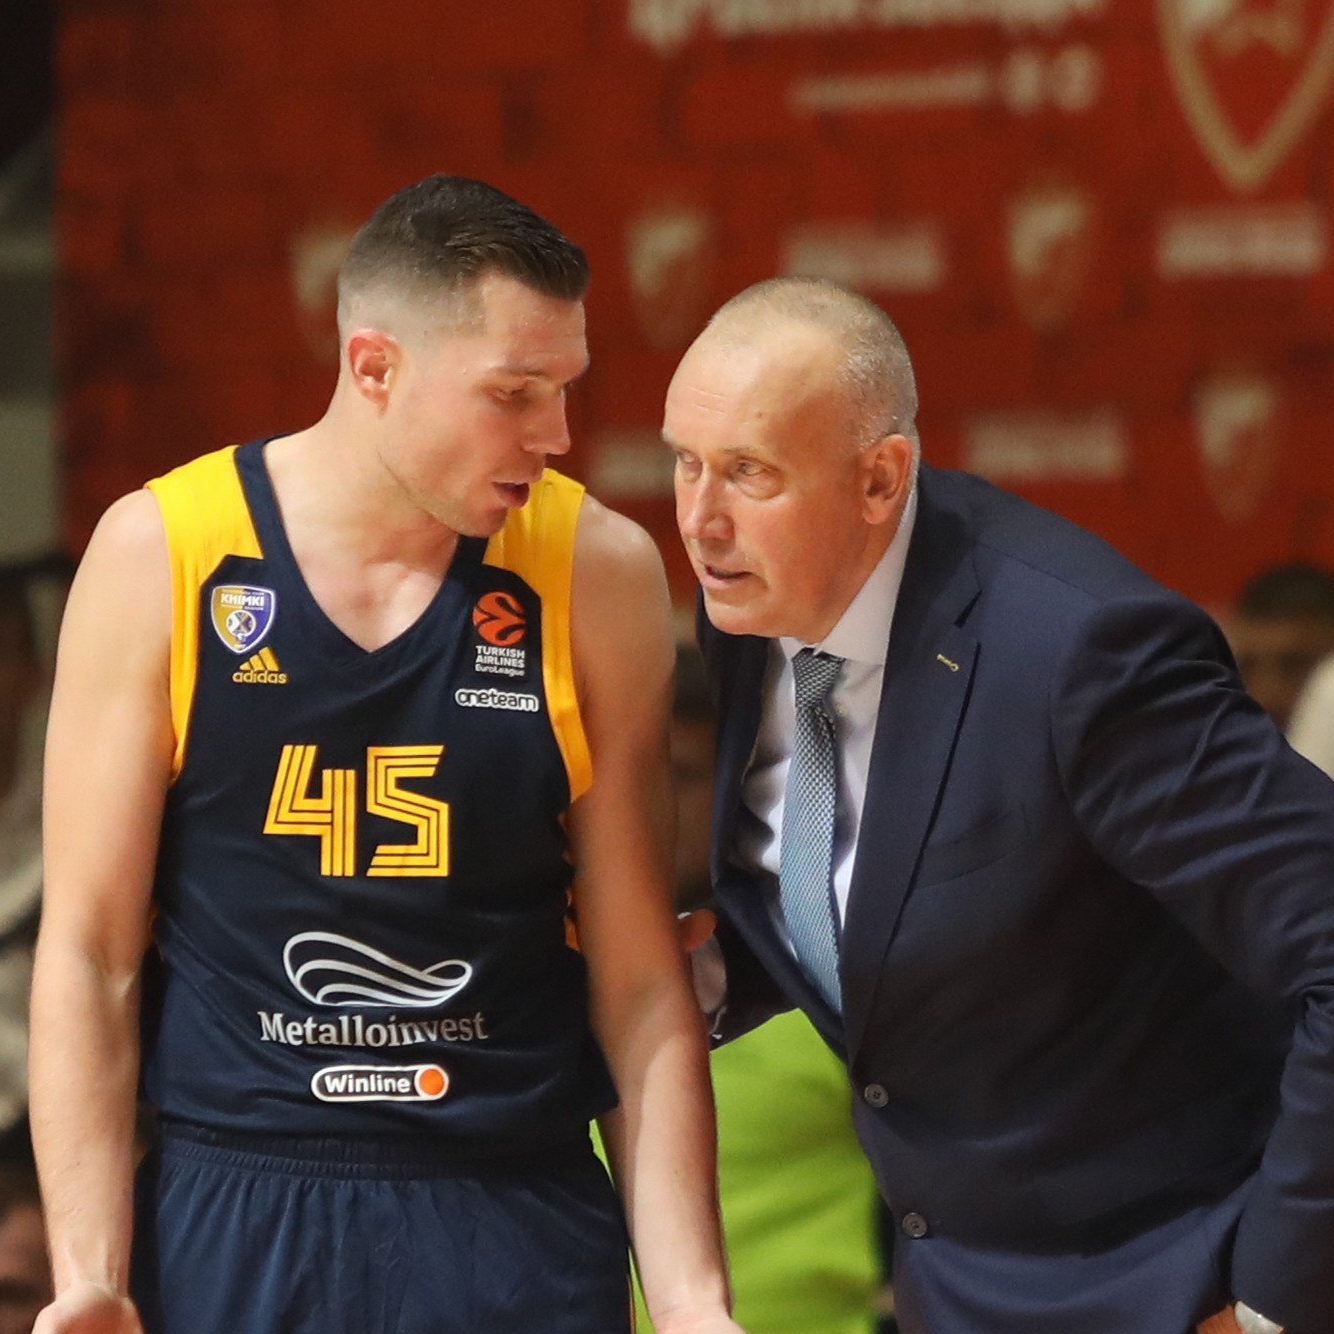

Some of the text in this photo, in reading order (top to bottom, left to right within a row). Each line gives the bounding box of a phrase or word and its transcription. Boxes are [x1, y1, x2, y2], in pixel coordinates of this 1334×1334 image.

[220, 592, 265, 607] KHIMKI
[475, 645, 525, 659] TURKISH
[475, 655, 525, 669] AIRLINES
[232, 669, 287, 684] adidas
[475, 663, 525, 677] EuroLeague
[455, 688, 539, 712] oneteam
[263, 745, 450, 877] 45
[257, 1010, 489, 1048] Metalloinvest
[324, 1074, 411, 1094] Winline
